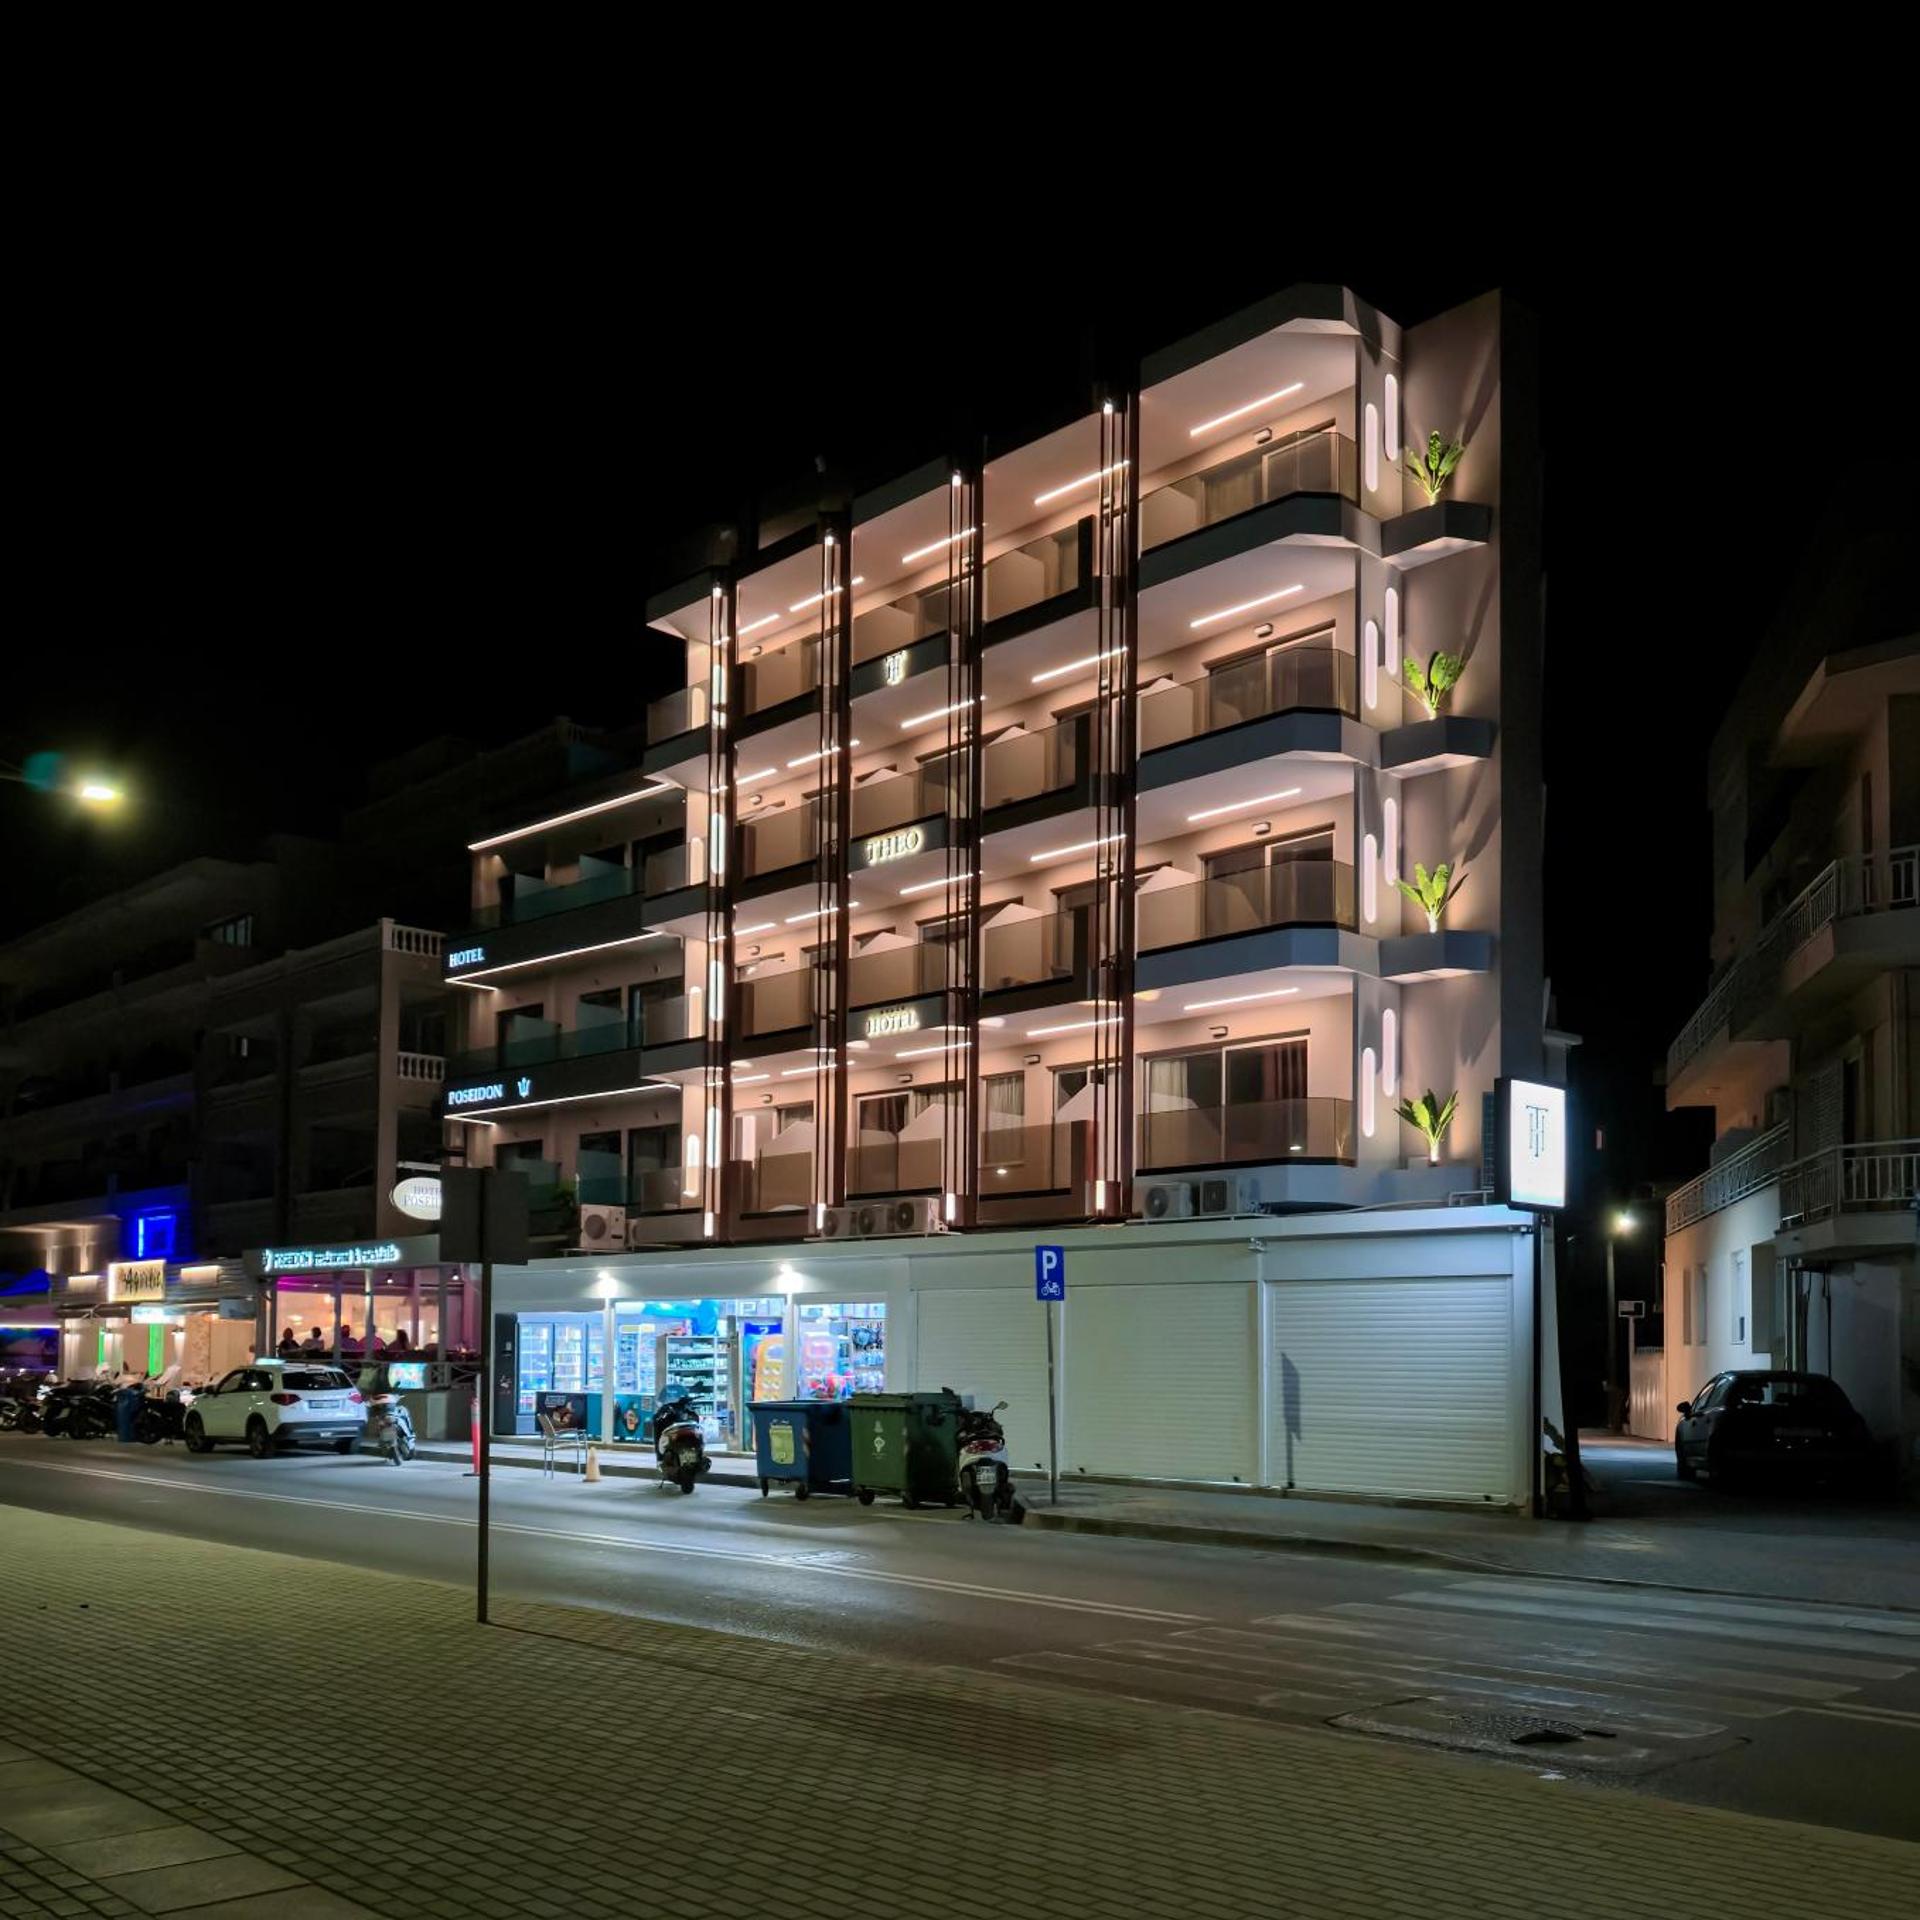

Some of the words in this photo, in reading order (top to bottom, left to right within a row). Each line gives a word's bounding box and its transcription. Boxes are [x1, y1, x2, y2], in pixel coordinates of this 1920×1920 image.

[449, 947, 485, 968] HOTEL
[866, 1011, 918, 1036] HOTEL
[448, 1083, 503, 1105] POSEIDON
[413, 1185, 441, 1195] HOTE
[1042, 1250, 1057, 1280] P
